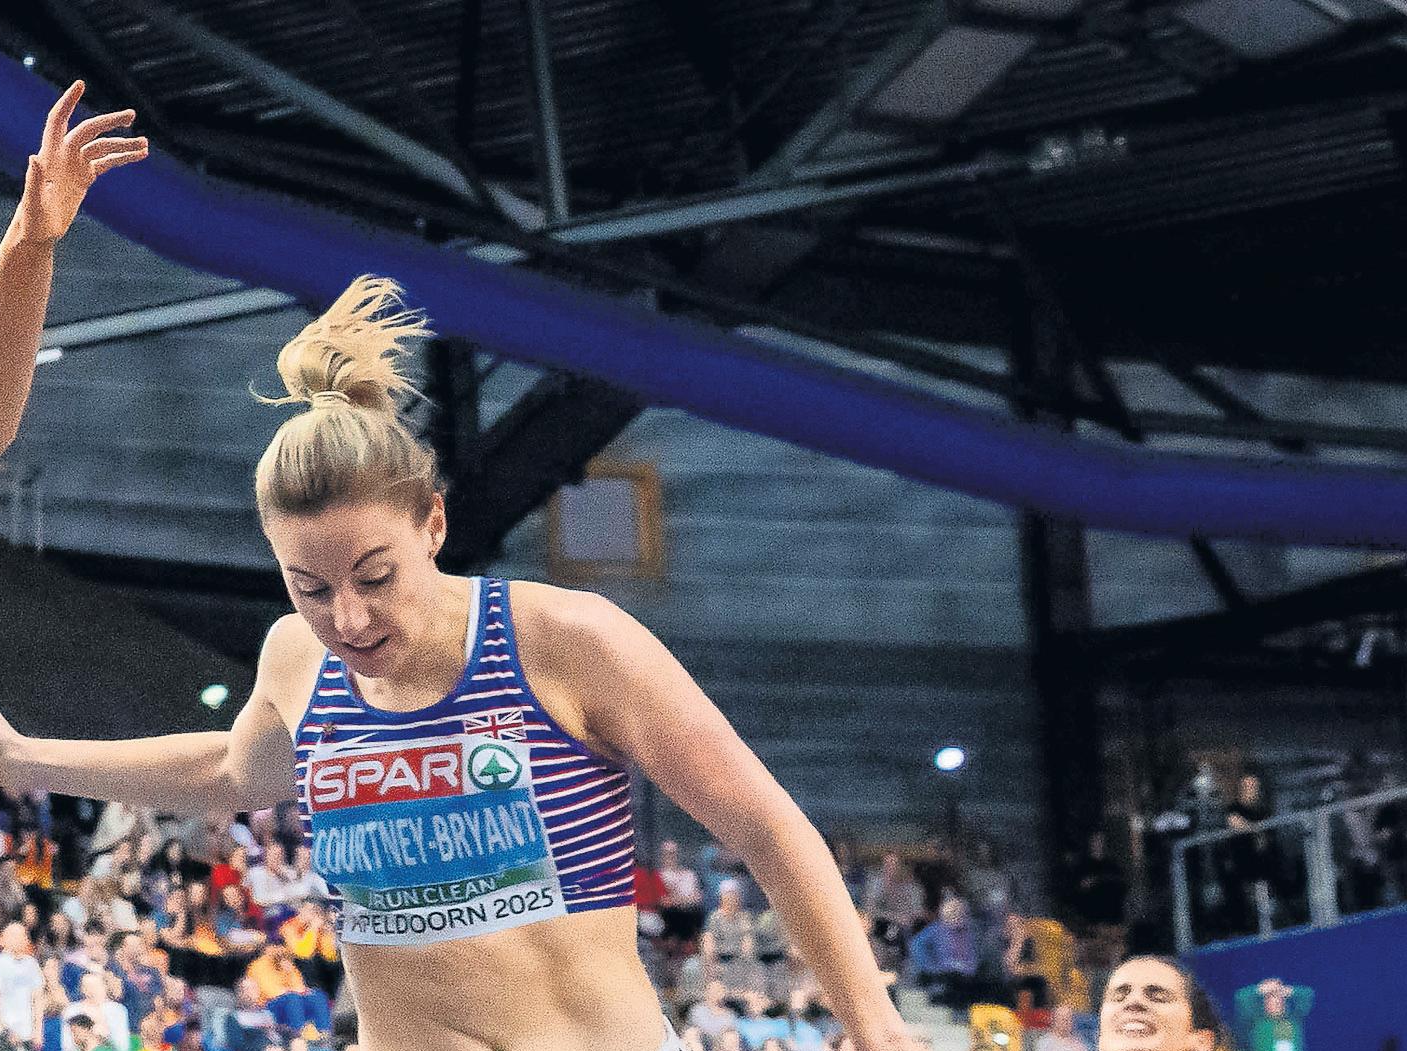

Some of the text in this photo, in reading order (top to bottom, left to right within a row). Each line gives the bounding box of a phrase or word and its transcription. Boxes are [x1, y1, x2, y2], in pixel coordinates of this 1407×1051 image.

[313, 751, 460, 803] SPAR
[313, 801, 538, 876] COURTNEY-BRYANT
[423, 877, 497, 904] CLEAN
[495, 887, 554, 920] 2025
